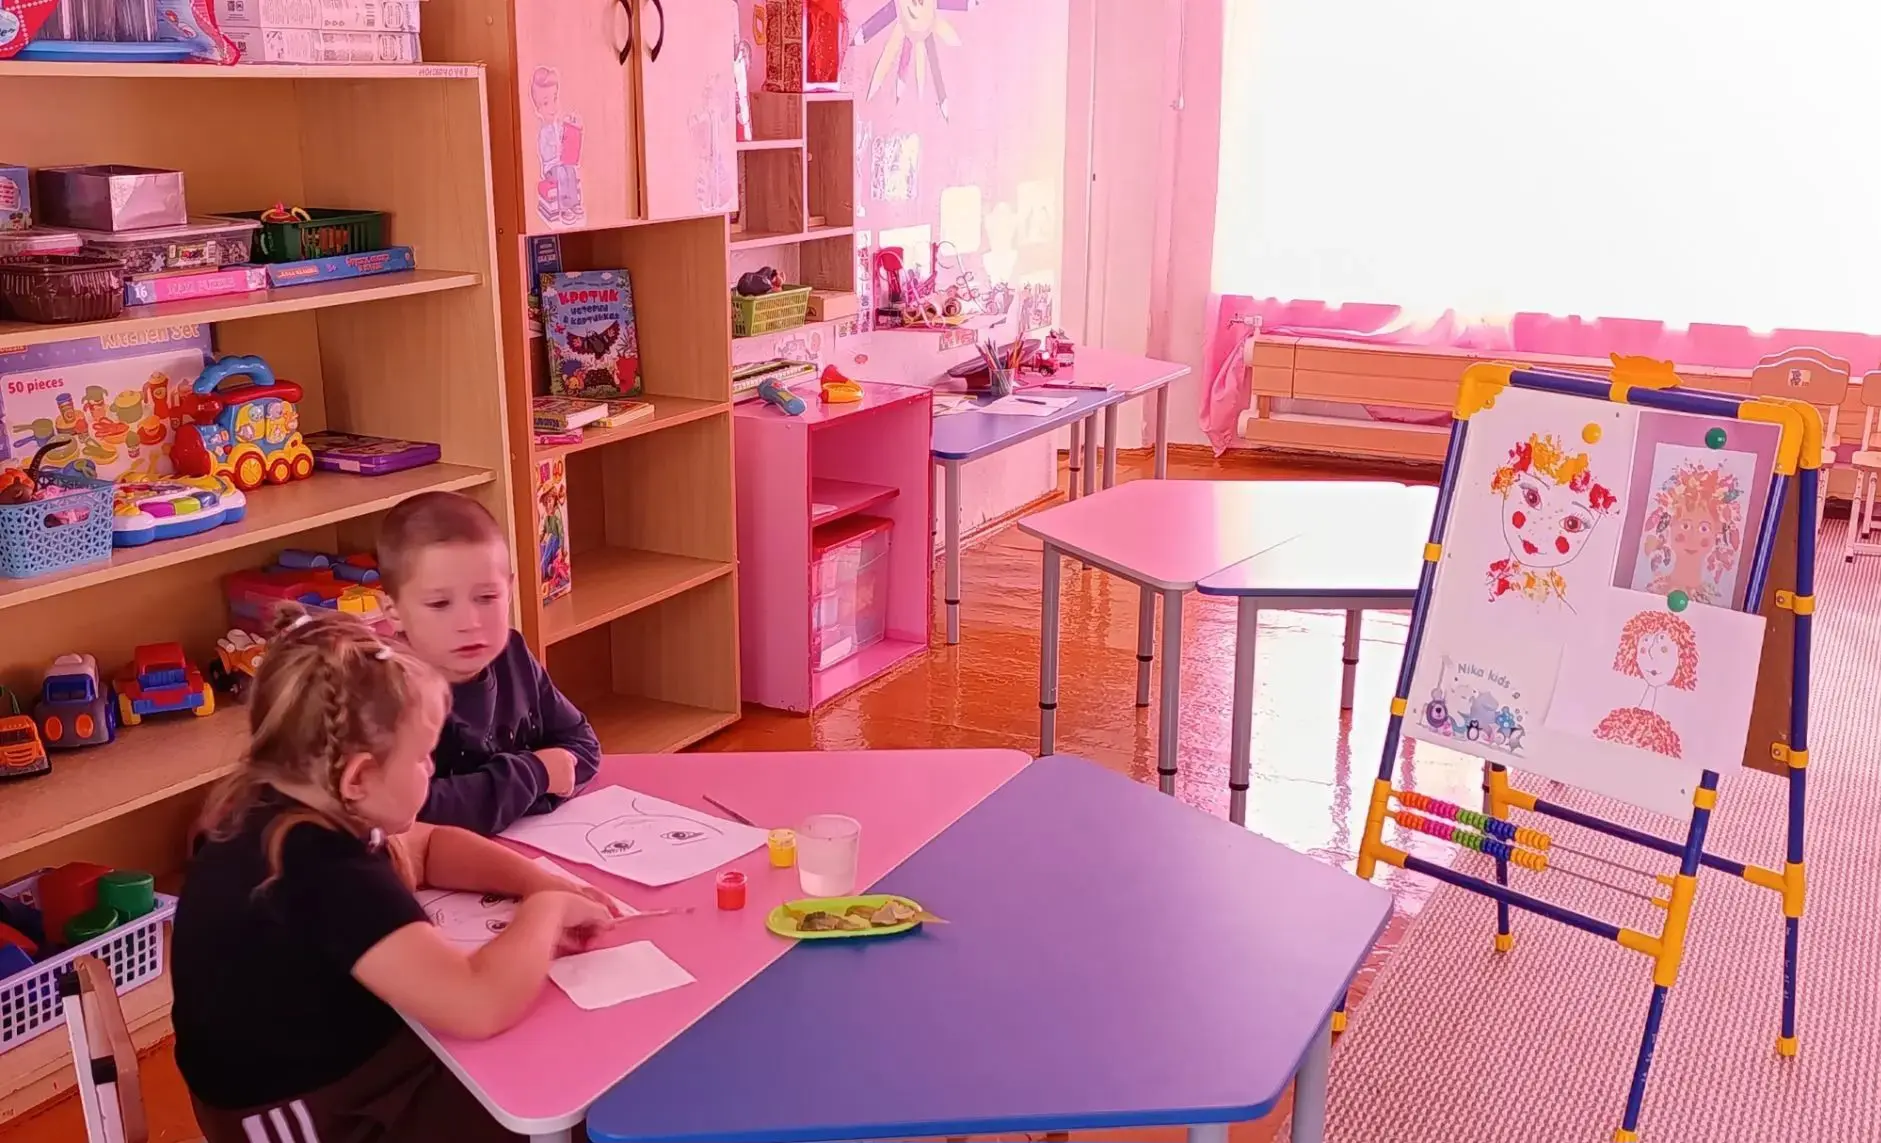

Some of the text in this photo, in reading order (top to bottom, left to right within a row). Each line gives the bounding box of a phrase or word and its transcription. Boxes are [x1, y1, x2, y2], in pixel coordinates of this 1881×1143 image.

[135, 286, 148, 298] 16
[557, 289, 620, 305] КРОТИК
[100, 323, 201, 350] Kitchen Set
[8, 376, 65, 395] 50 pieces
[1457, 663, 1511, 689] Nika kids
